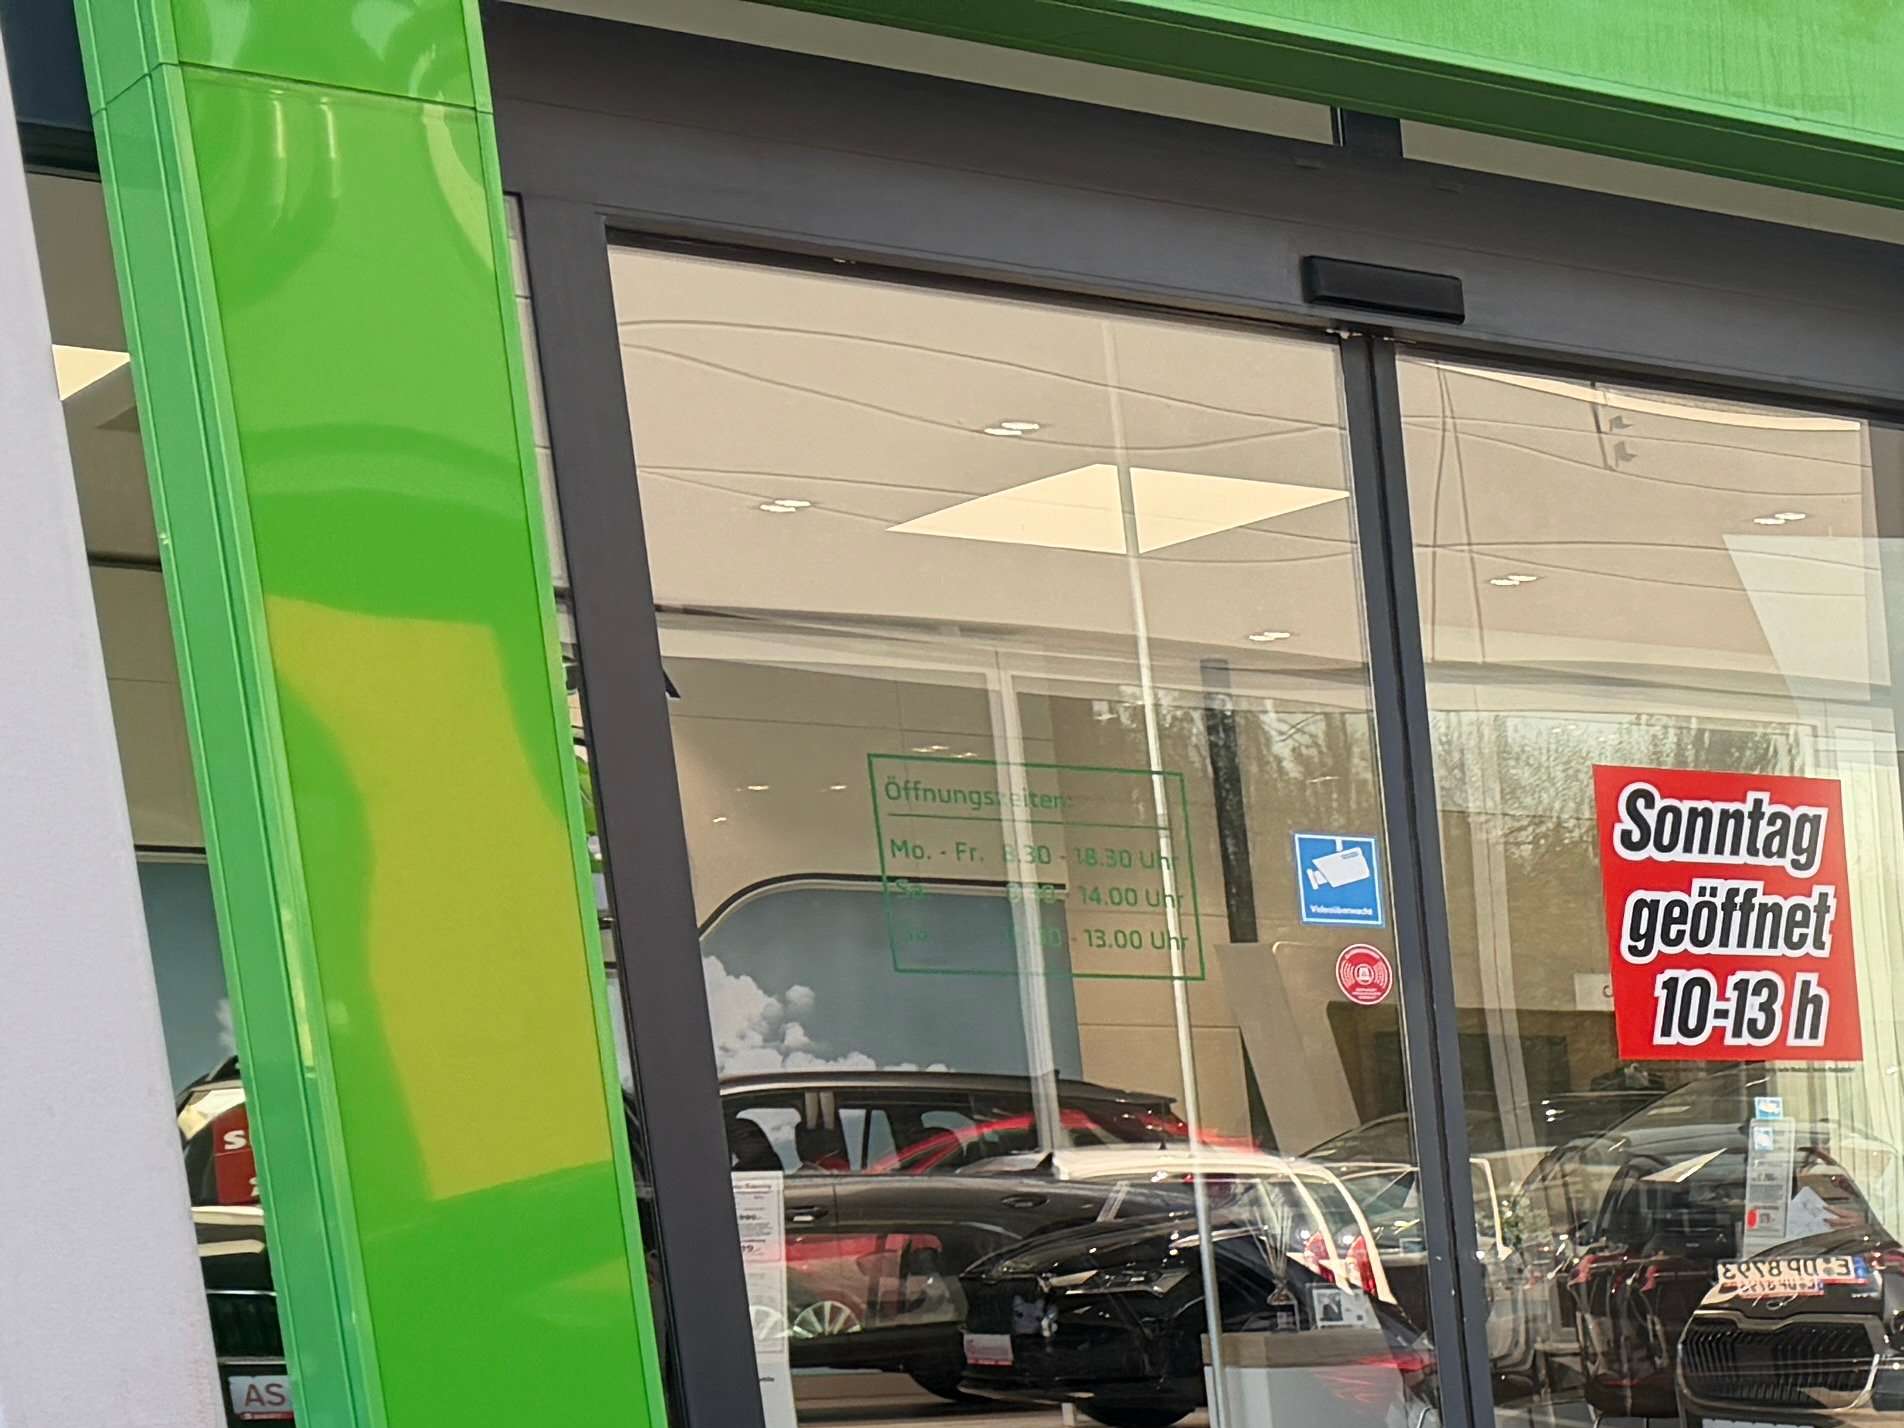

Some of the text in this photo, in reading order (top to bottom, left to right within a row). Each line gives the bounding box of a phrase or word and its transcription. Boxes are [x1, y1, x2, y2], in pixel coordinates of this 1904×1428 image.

[1620, 788, 1821, 871] Sonntag
[890, 839, 930, 860] Mo.
[955, 842, 984, 862] Fr.
[1080, 886, 1138, 906] 14.00
[1627, 886, 1830, 958] geöffnet
[1084, 929, 1142, 950] 13.00
[1660, 976, 1824, 1040] 10-13 h
[243, 1383, 286, 1408] AS
